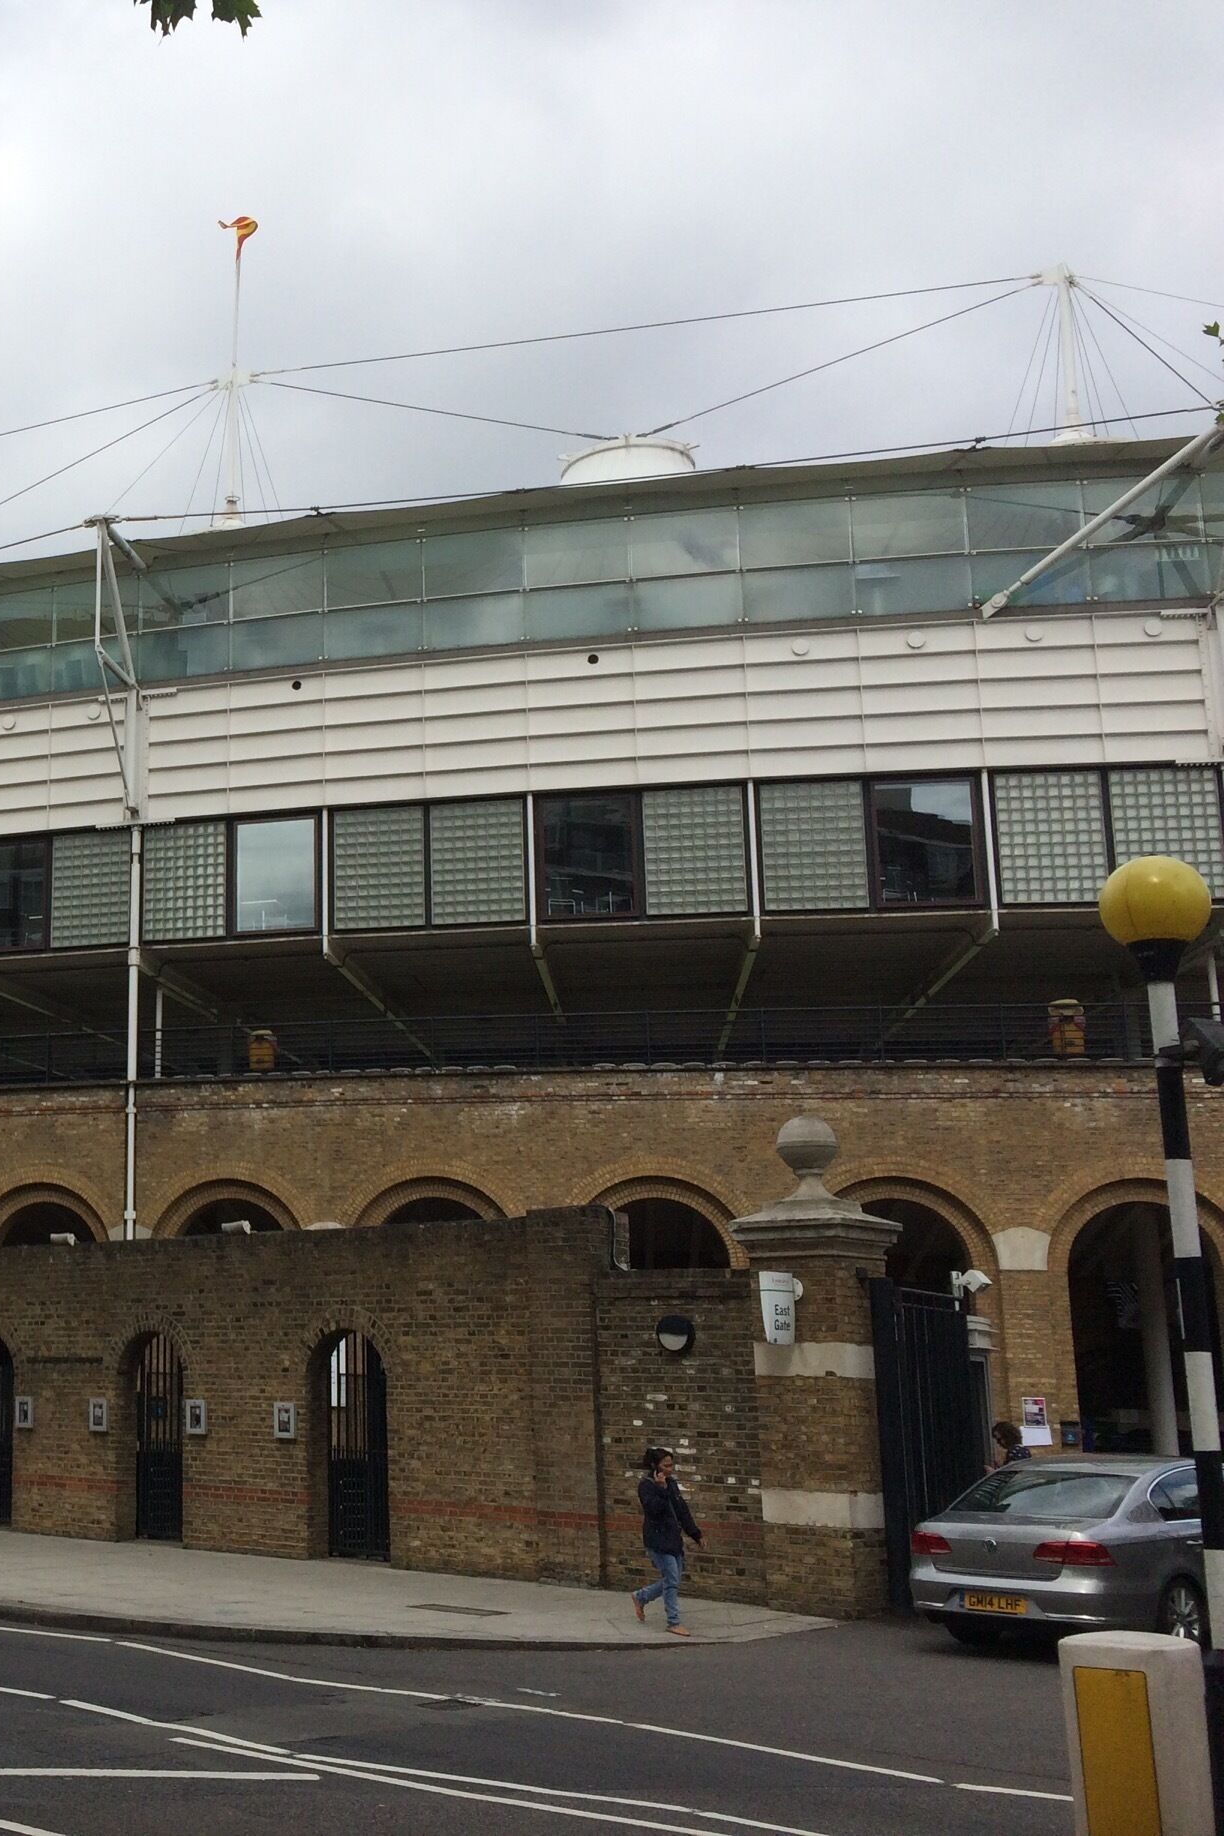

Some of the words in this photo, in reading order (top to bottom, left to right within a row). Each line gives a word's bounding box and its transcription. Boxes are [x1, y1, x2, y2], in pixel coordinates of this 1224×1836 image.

[774, 1304, 791, 1316] East
[774, 1318, 791, 1331] Gate
[997, 1597, 1022, 1611] LHF
